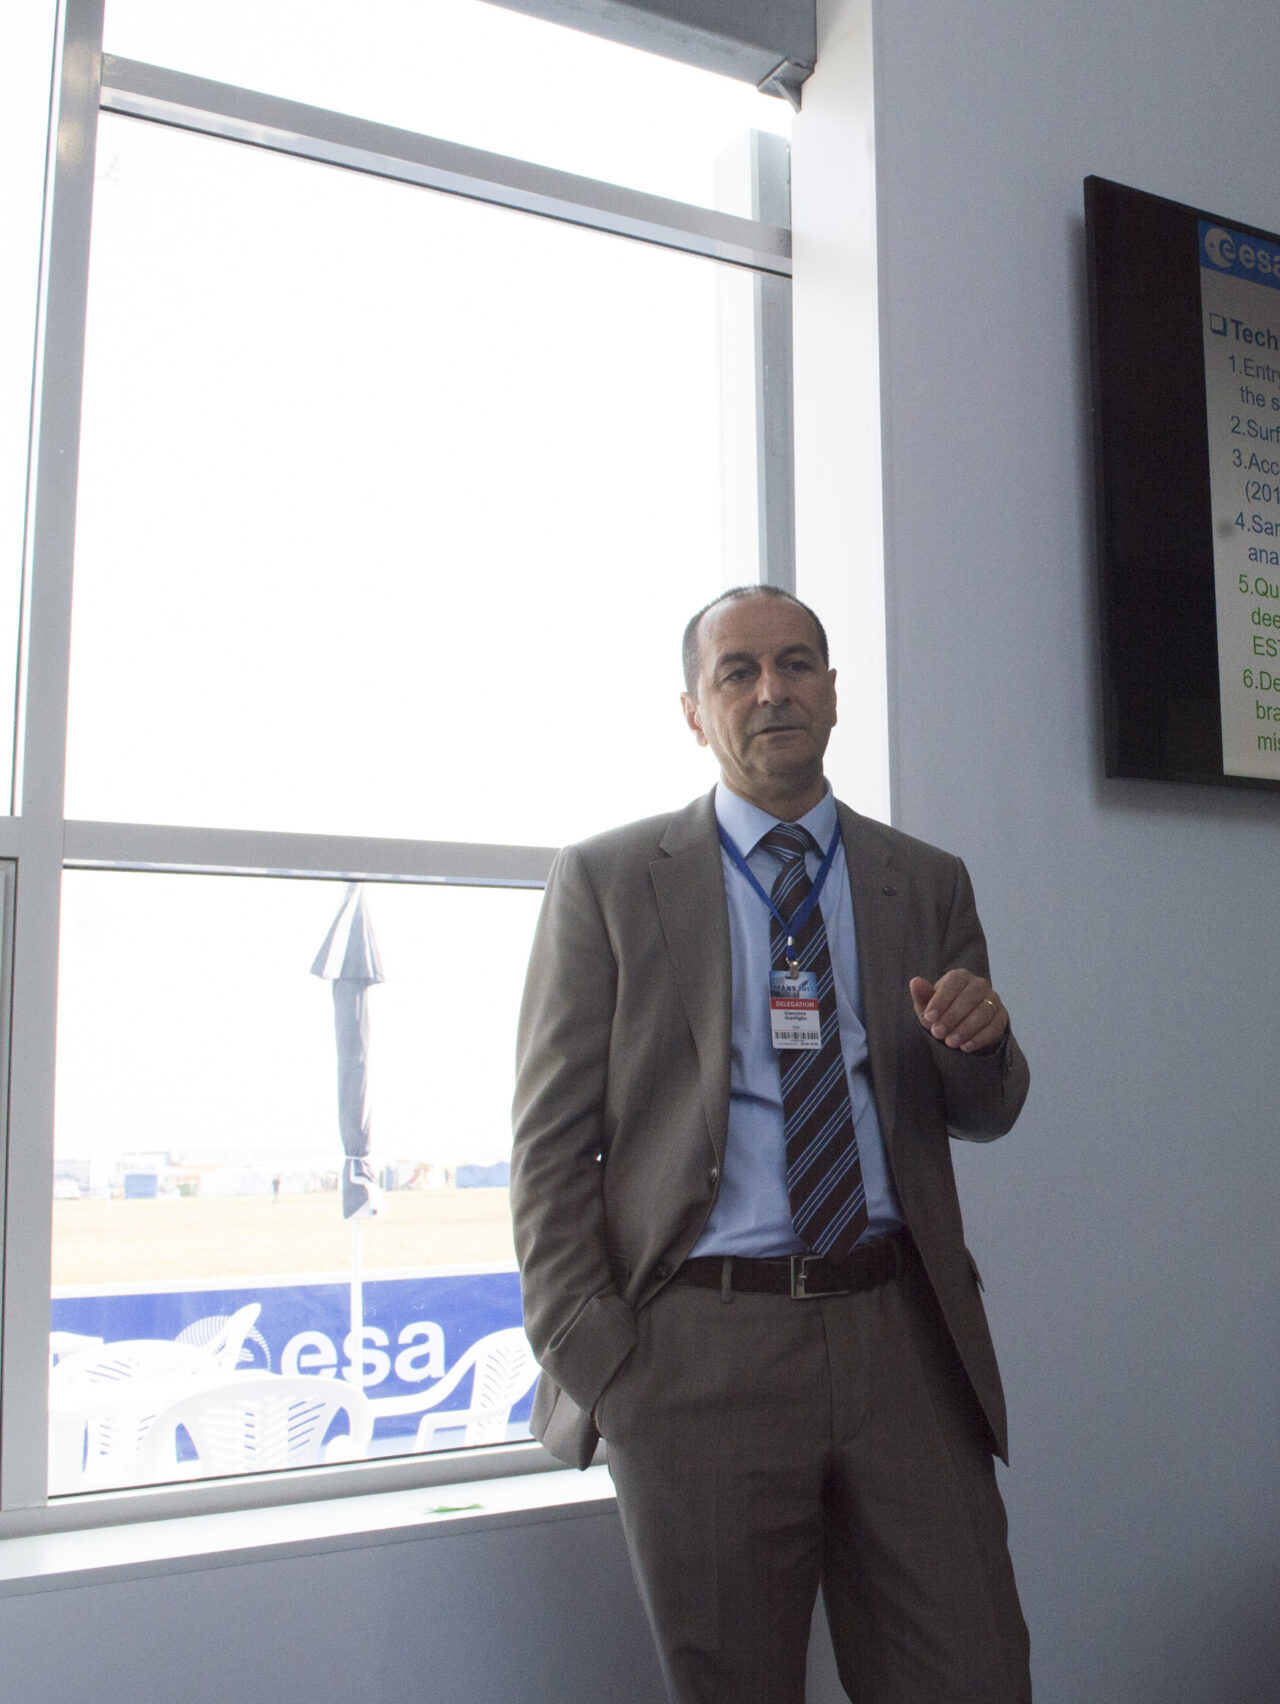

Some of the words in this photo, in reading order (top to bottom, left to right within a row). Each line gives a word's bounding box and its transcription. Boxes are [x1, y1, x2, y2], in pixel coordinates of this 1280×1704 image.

[1239, 385, 1266, 408] the
[776, 1000, 815, 1008] DELEGATION
[280, 1321, 446, 1387] esa
